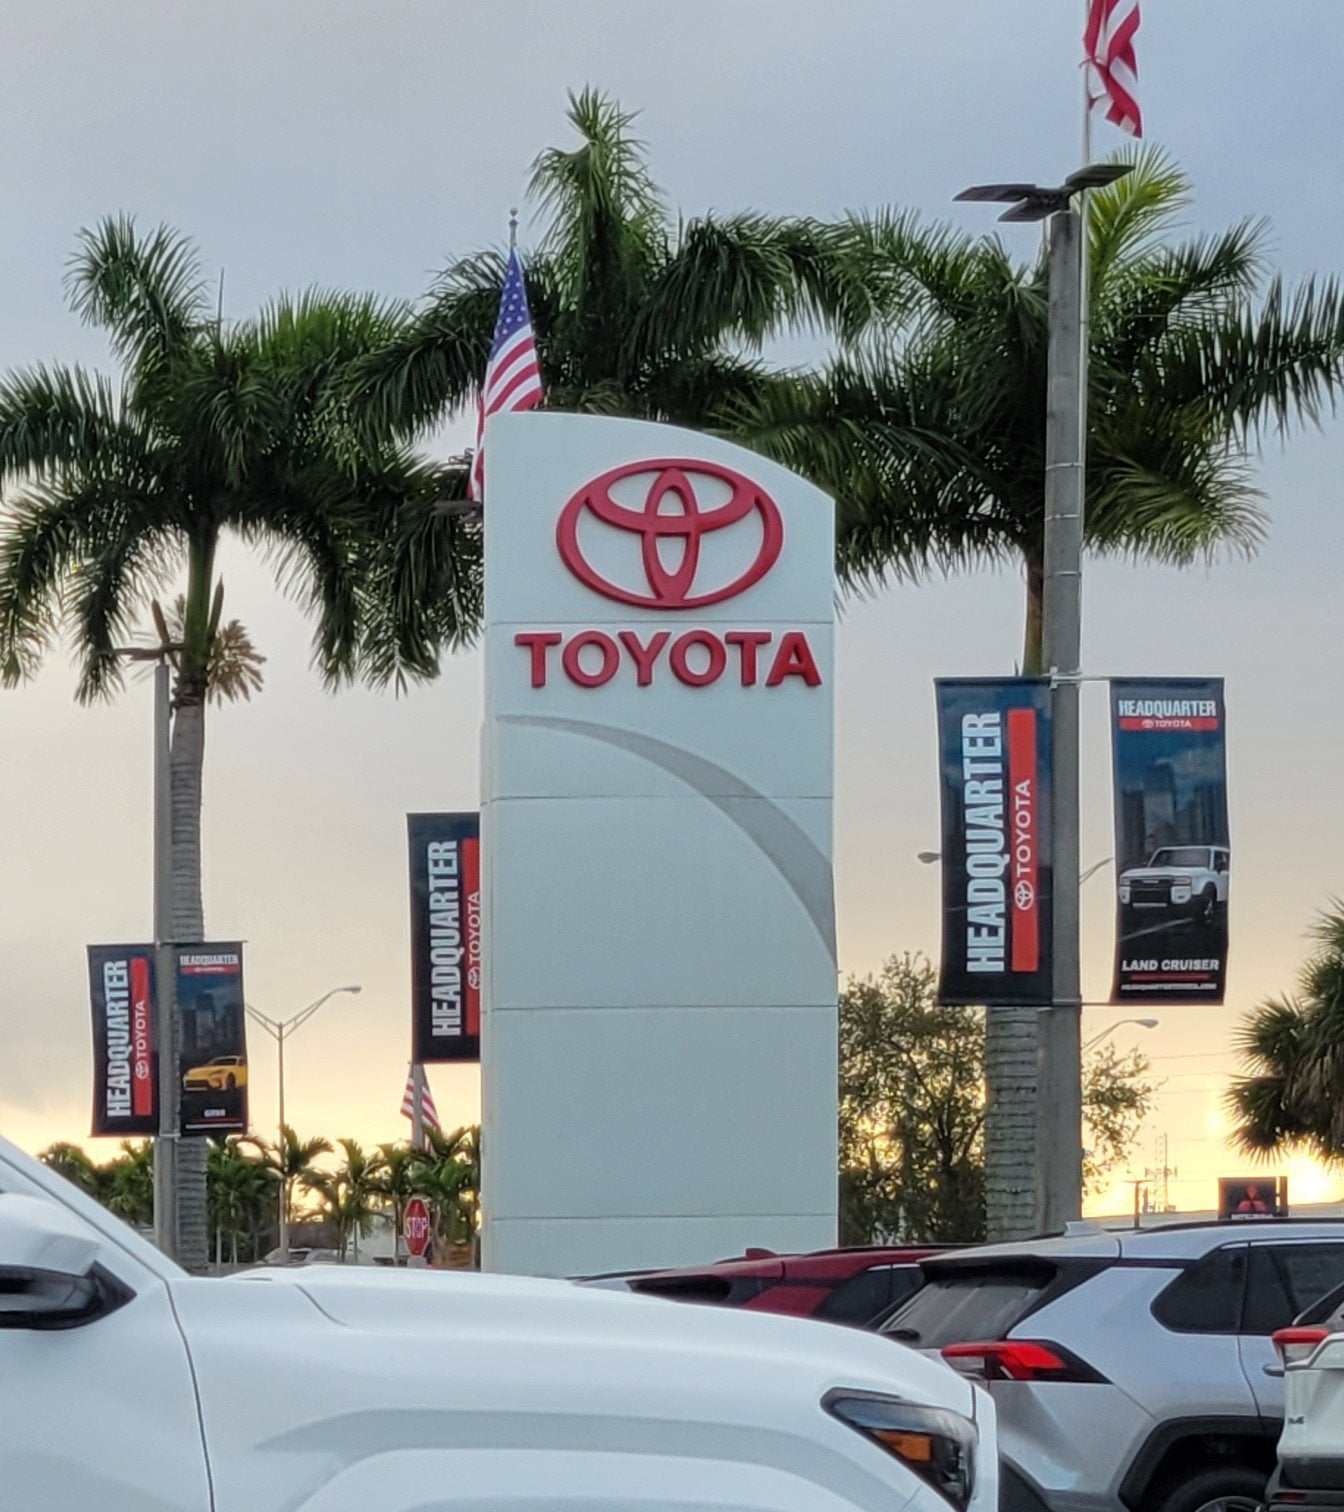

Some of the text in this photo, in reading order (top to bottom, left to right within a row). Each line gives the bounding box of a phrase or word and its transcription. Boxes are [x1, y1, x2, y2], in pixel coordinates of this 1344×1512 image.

[515, 630, 822, 688] TOYOTA
[1118, 700, 1216, 719] HEADQUARTER
[962, 711, 1010, 972] HEADQUARTER
[1015, 780, 1031, 876] TOYOTA
[427, 840, 465, 1036] HEADQUARTER
[468, 891, 479, 964] TOYOTA
[1121, 959, 1220, 971] LAND CRUISER
[103, 960, 133, 1117] HEADQUARTER
[134, 1000, 147, 1062] TOYOTA
